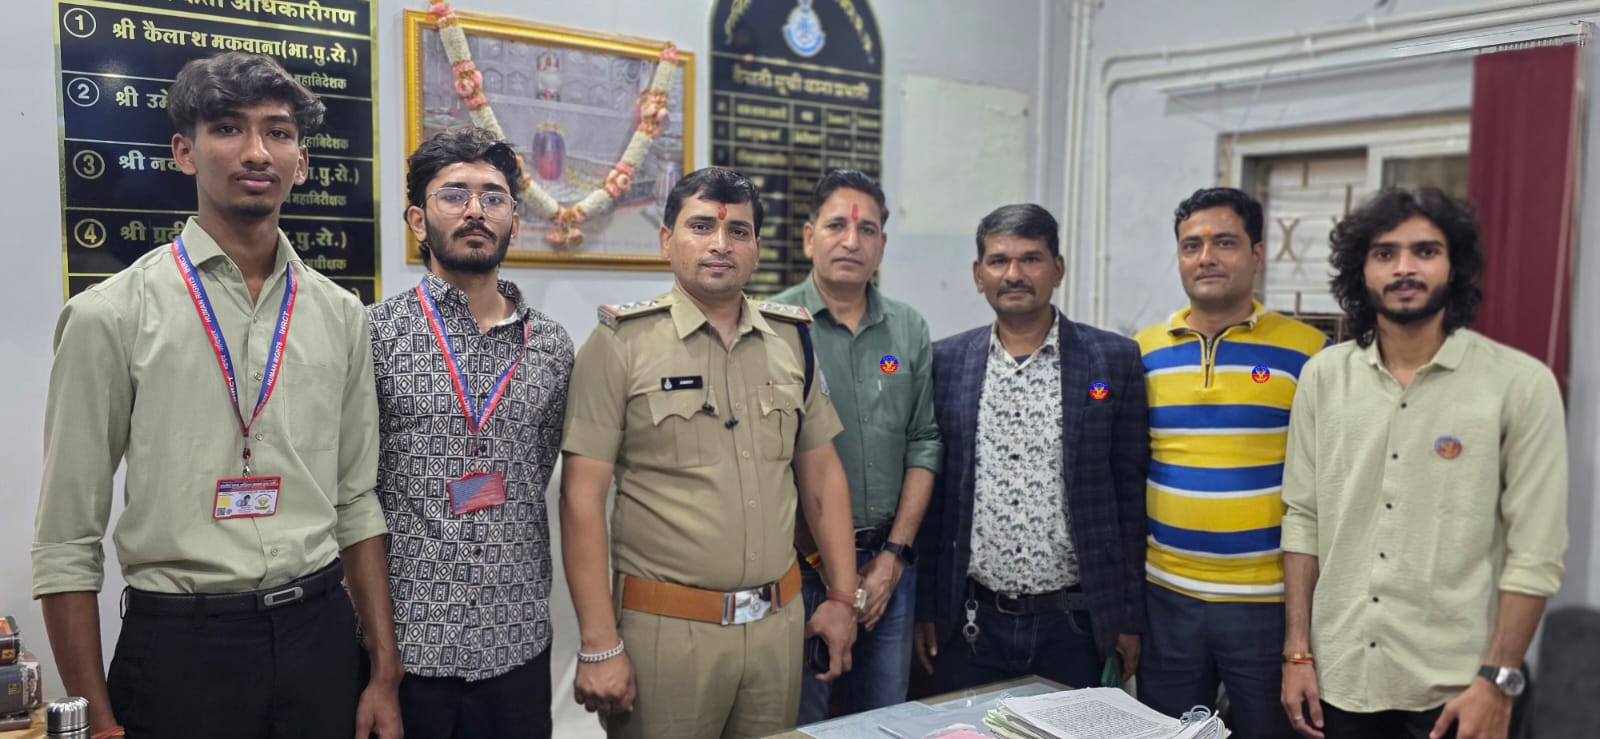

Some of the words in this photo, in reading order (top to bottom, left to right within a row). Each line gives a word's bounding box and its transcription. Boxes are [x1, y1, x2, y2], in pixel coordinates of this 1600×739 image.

[113, 17, 136, 40] श्री
[77, 83, 90, 100] 2
[116, 85, 139, 108] श्री
[83, 154, 95, 174] 3
[118, 149, 146, 170] श्री
[84, 223, 97, 244] 4
[120, 220, 146, 241] श्री
